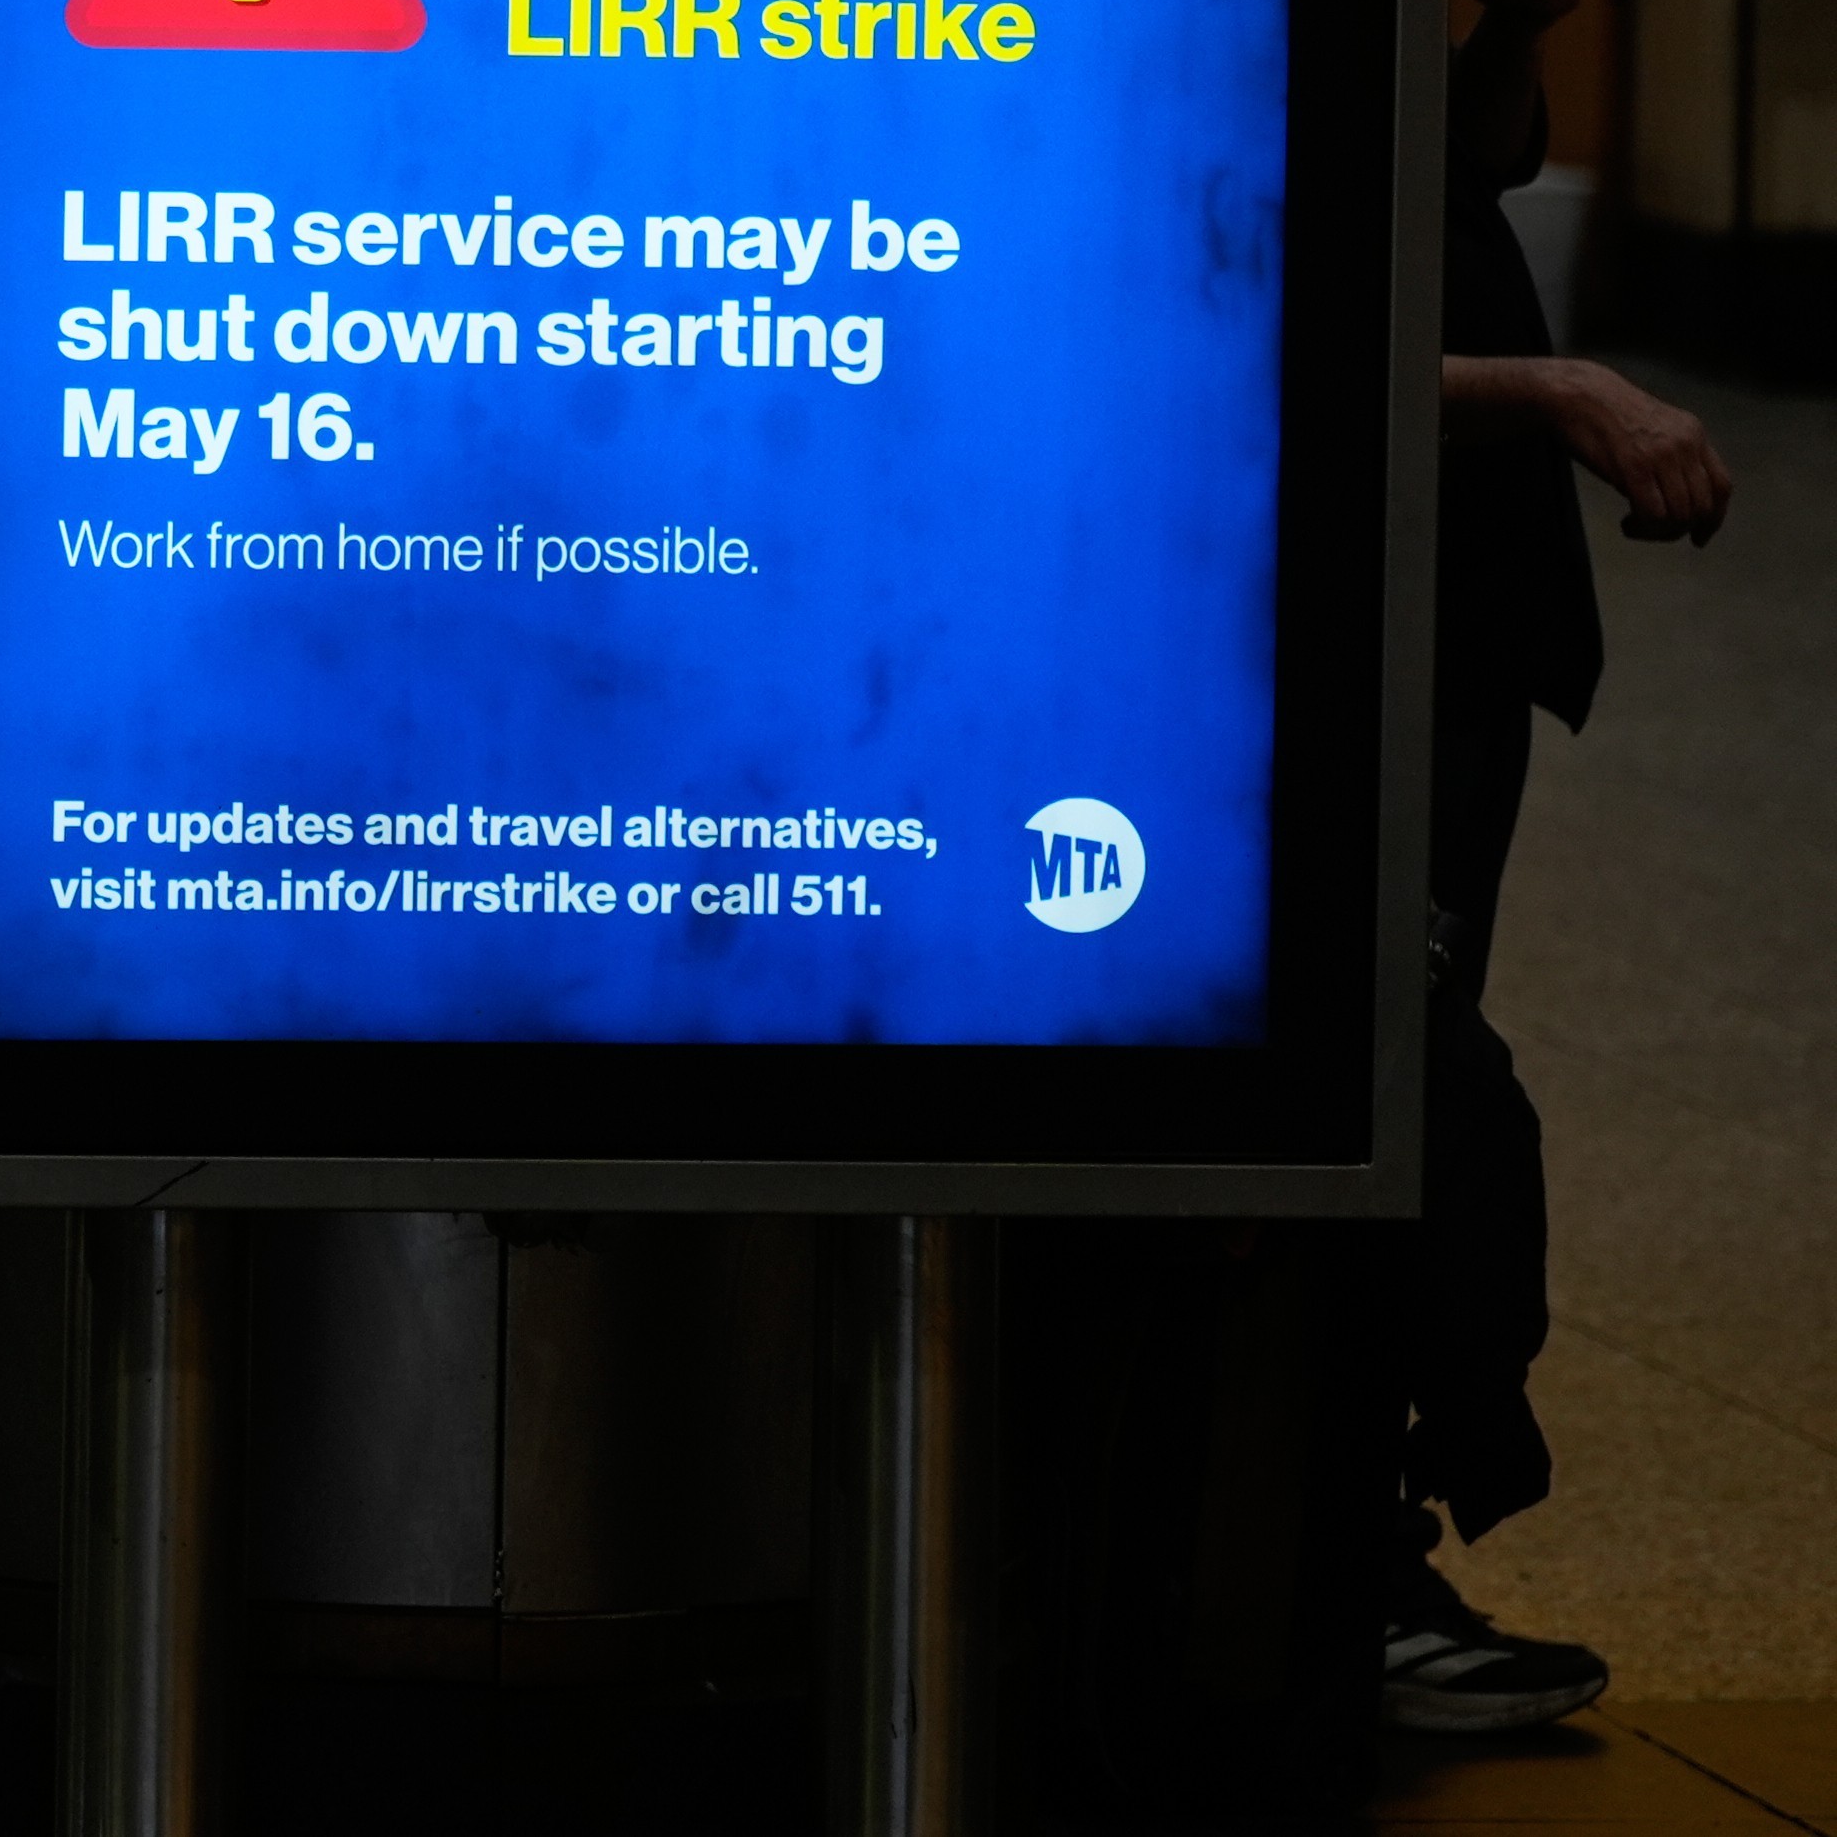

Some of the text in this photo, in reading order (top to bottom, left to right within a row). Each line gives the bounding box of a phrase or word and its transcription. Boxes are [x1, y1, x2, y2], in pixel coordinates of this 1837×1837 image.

[64, 191, 960, 285] LIRR service may be
[58, 290, 883, 384] shut down starting
[64, 389, 374, 474] May 16.
[59, 521, 758, 581] Work from home if possible.
[54, 801, 937, 858] For updates and travel alternatives,
[1024, 828, 1121, 903] MTA
[51, 868, 881, 915] visit mta.info/lirrstrike or call 511.
